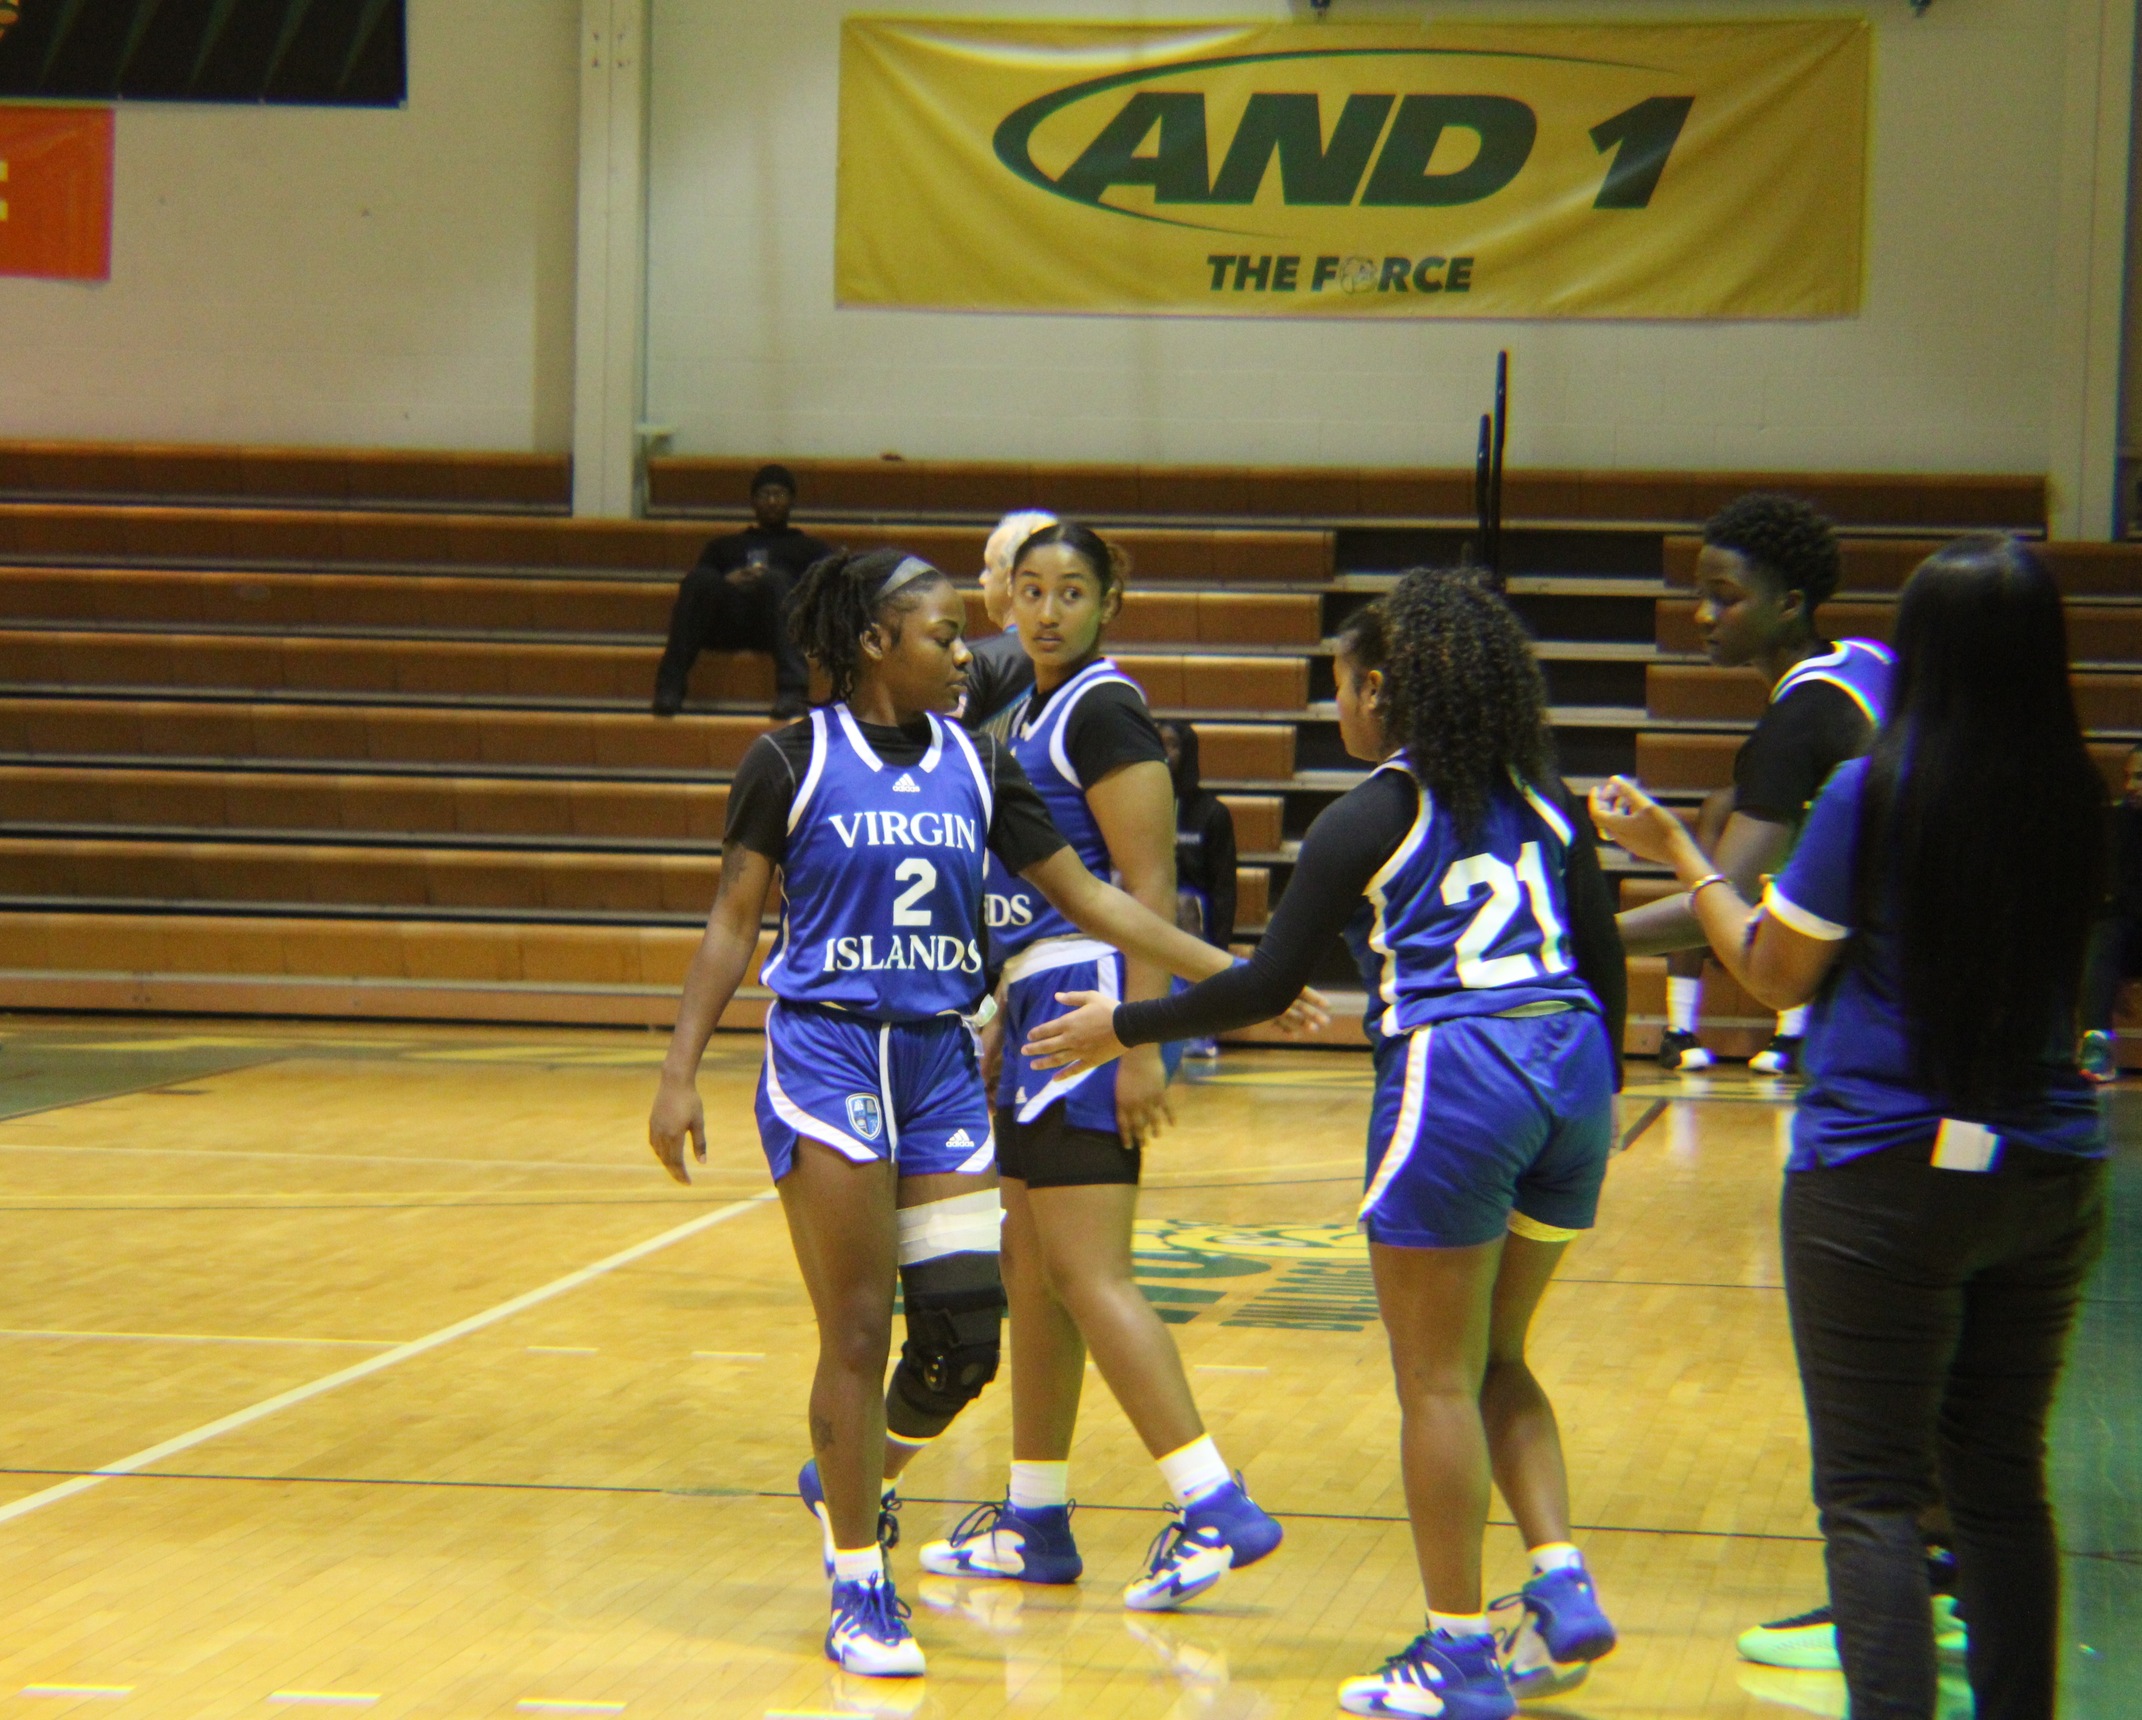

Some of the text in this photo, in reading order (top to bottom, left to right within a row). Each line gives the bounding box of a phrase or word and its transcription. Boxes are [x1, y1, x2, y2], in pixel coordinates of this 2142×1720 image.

[1055, 91, 1697, 210] AND 1
[1206, 254, 1301, 292] THE
[828, 811, 976, 853] VIRGIN
[893, 858, 937, 926] 2
[1439, 840, 1570, 989] 21
[822, 934, 982, 974] ISLANDS
[945, 1140, 975, 1148] adidas
